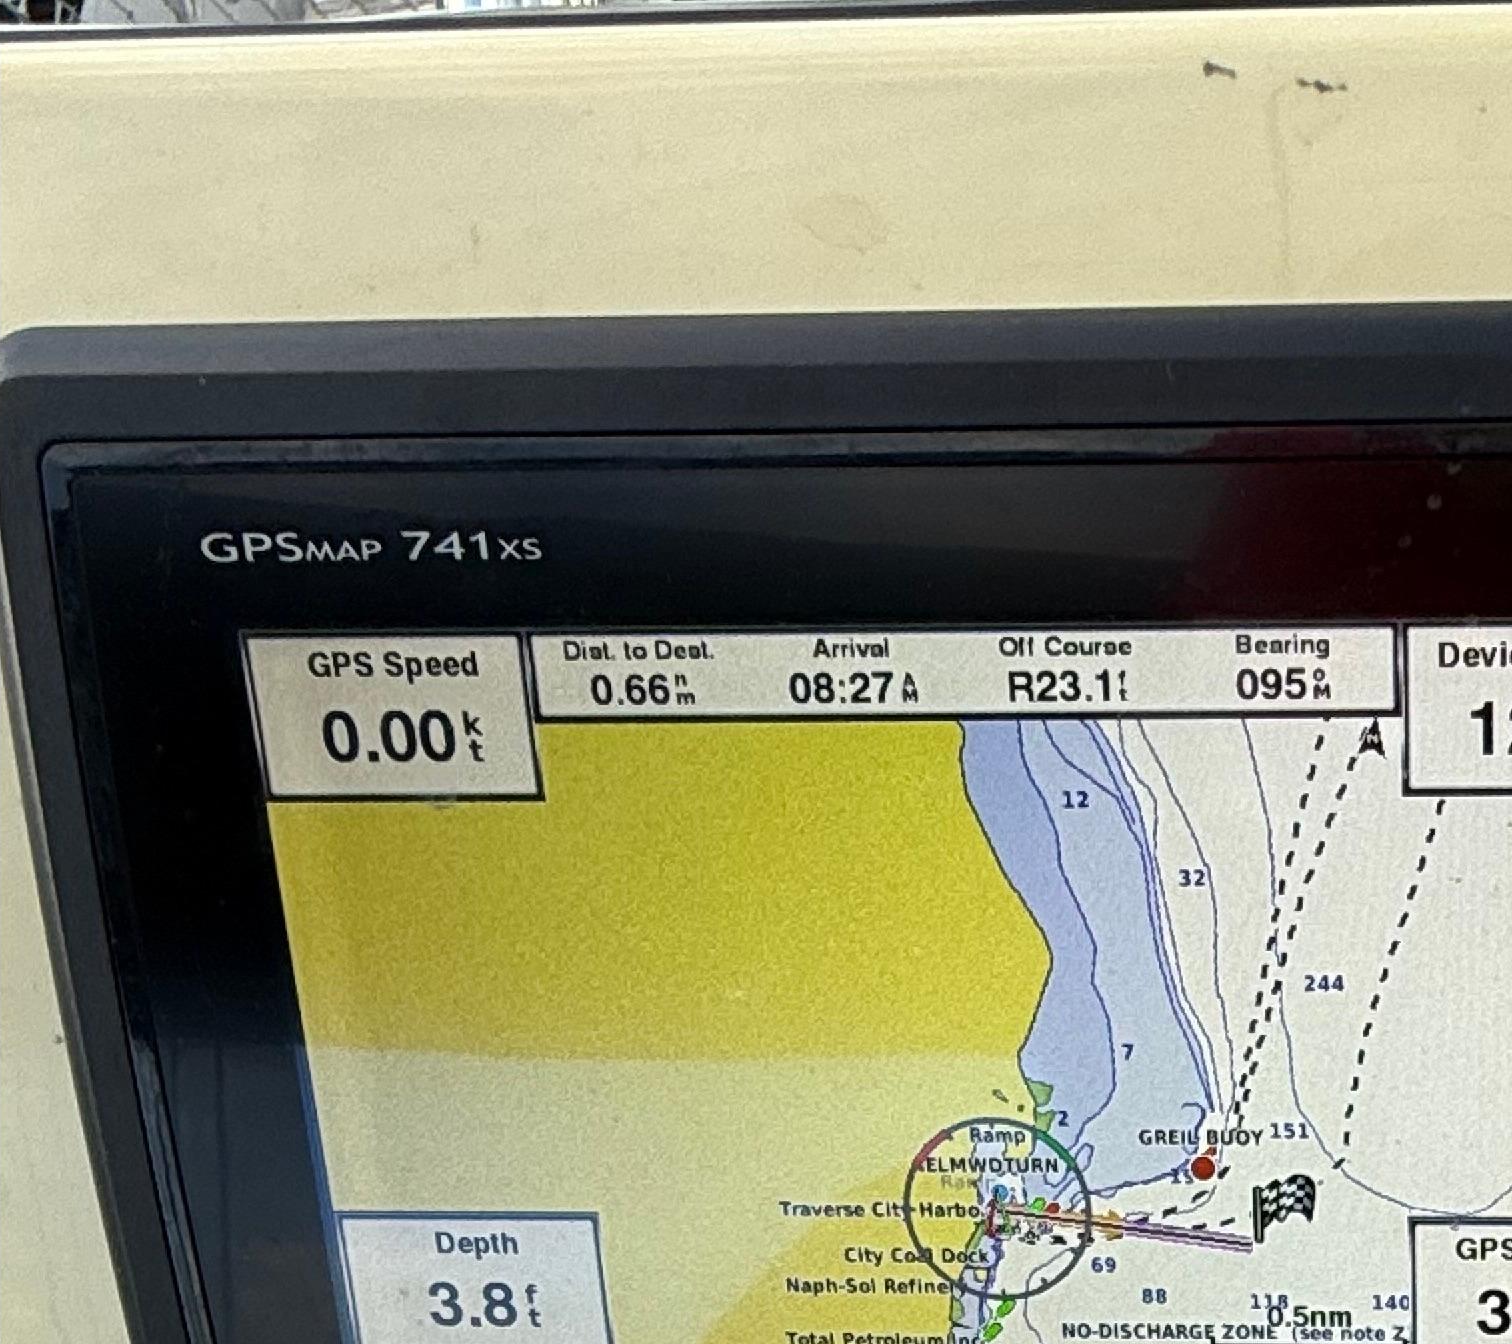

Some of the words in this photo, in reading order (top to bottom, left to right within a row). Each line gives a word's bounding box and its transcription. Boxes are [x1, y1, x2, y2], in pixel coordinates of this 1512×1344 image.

[624, 640, 647, 660] to
[813, 638, 890, 659] Arrival
[999, 636, 1034, 656] Off
[1044, 636, 1132, 657] Course
[1235, 634, 1331, 659] Bearing
[308, 652, 374, 679] GPS
[384, 651, 479, 685] Speed
[591, 673, 670, 706] 0.66
[789, 672, 894, 705] 08:27
[1236, 668, 1306, 699] 095
[322, 710, 456, 762] 0.00
[1063, 791, 1089, 809] 12
[1179, 869, 1205, 887] 32
[1304, 975, 1345, 992] 244
[1121, 1044, 1134, 1061] 7
[1058, 1111, 1069, 1127] 2
[969, 1127, 1026, 1147] Ramp
[1138, 1130, 1199, 1146] GREIL
[1207, 1130, 1264, 1146] BUOY
[1270, 1123, 1310, 1140] 151
[779, 1200, 865, 1217] Traverse
[872, 1201, 911, 1220] Cit
[919, 1201, 983, 1218] Harbo
[434, 1232, 519, 1259] Depth
[844, 1248, 883, 1267] City
[942, 1248, 989, 1264] Dock
[1091, 1256, 1116, 1273] 69
[786, 1277, 876, 1296] Naph-Sol
[428, 1281, 517, 1328] 3.8
[1372, 1294, 1410, 1311] 140
[1267, 1305, 1352, 1328] 0.5nm
[1062, 1322, 1216, 1340] NO-DISCHARGE
[1222, 1324, 1278, 1340] ZONE
[1292, 1326, 1334, 1342] (see
[1340, 1327, 1386, 1342] note
